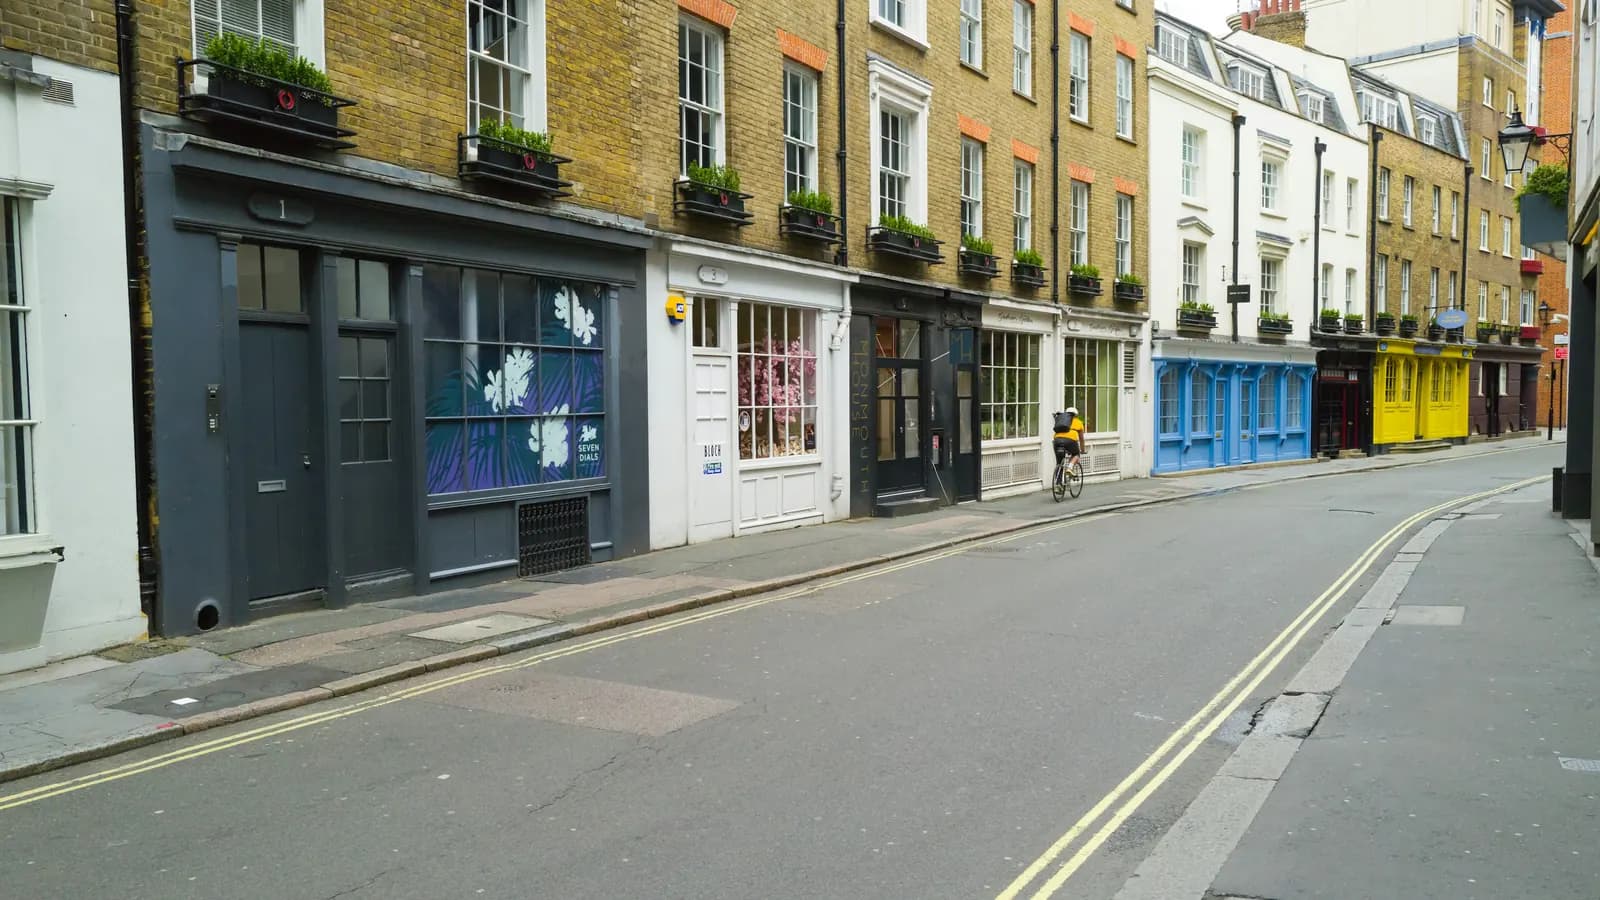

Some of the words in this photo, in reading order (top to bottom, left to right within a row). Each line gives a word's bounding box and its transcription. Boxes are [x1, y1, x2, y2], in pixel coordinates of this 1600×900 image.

[279, 199, 286, 219] 1
[711, 269, 717, 280] 3
[851, 353, 860, 440] HOUSE
[860, 340, 869, 493] MONMOUTH
[578, 443, 600, 453] SEVEN
[704, 444, 721, 458] BLOCH
[579, 452, 599, 462] DIALS
